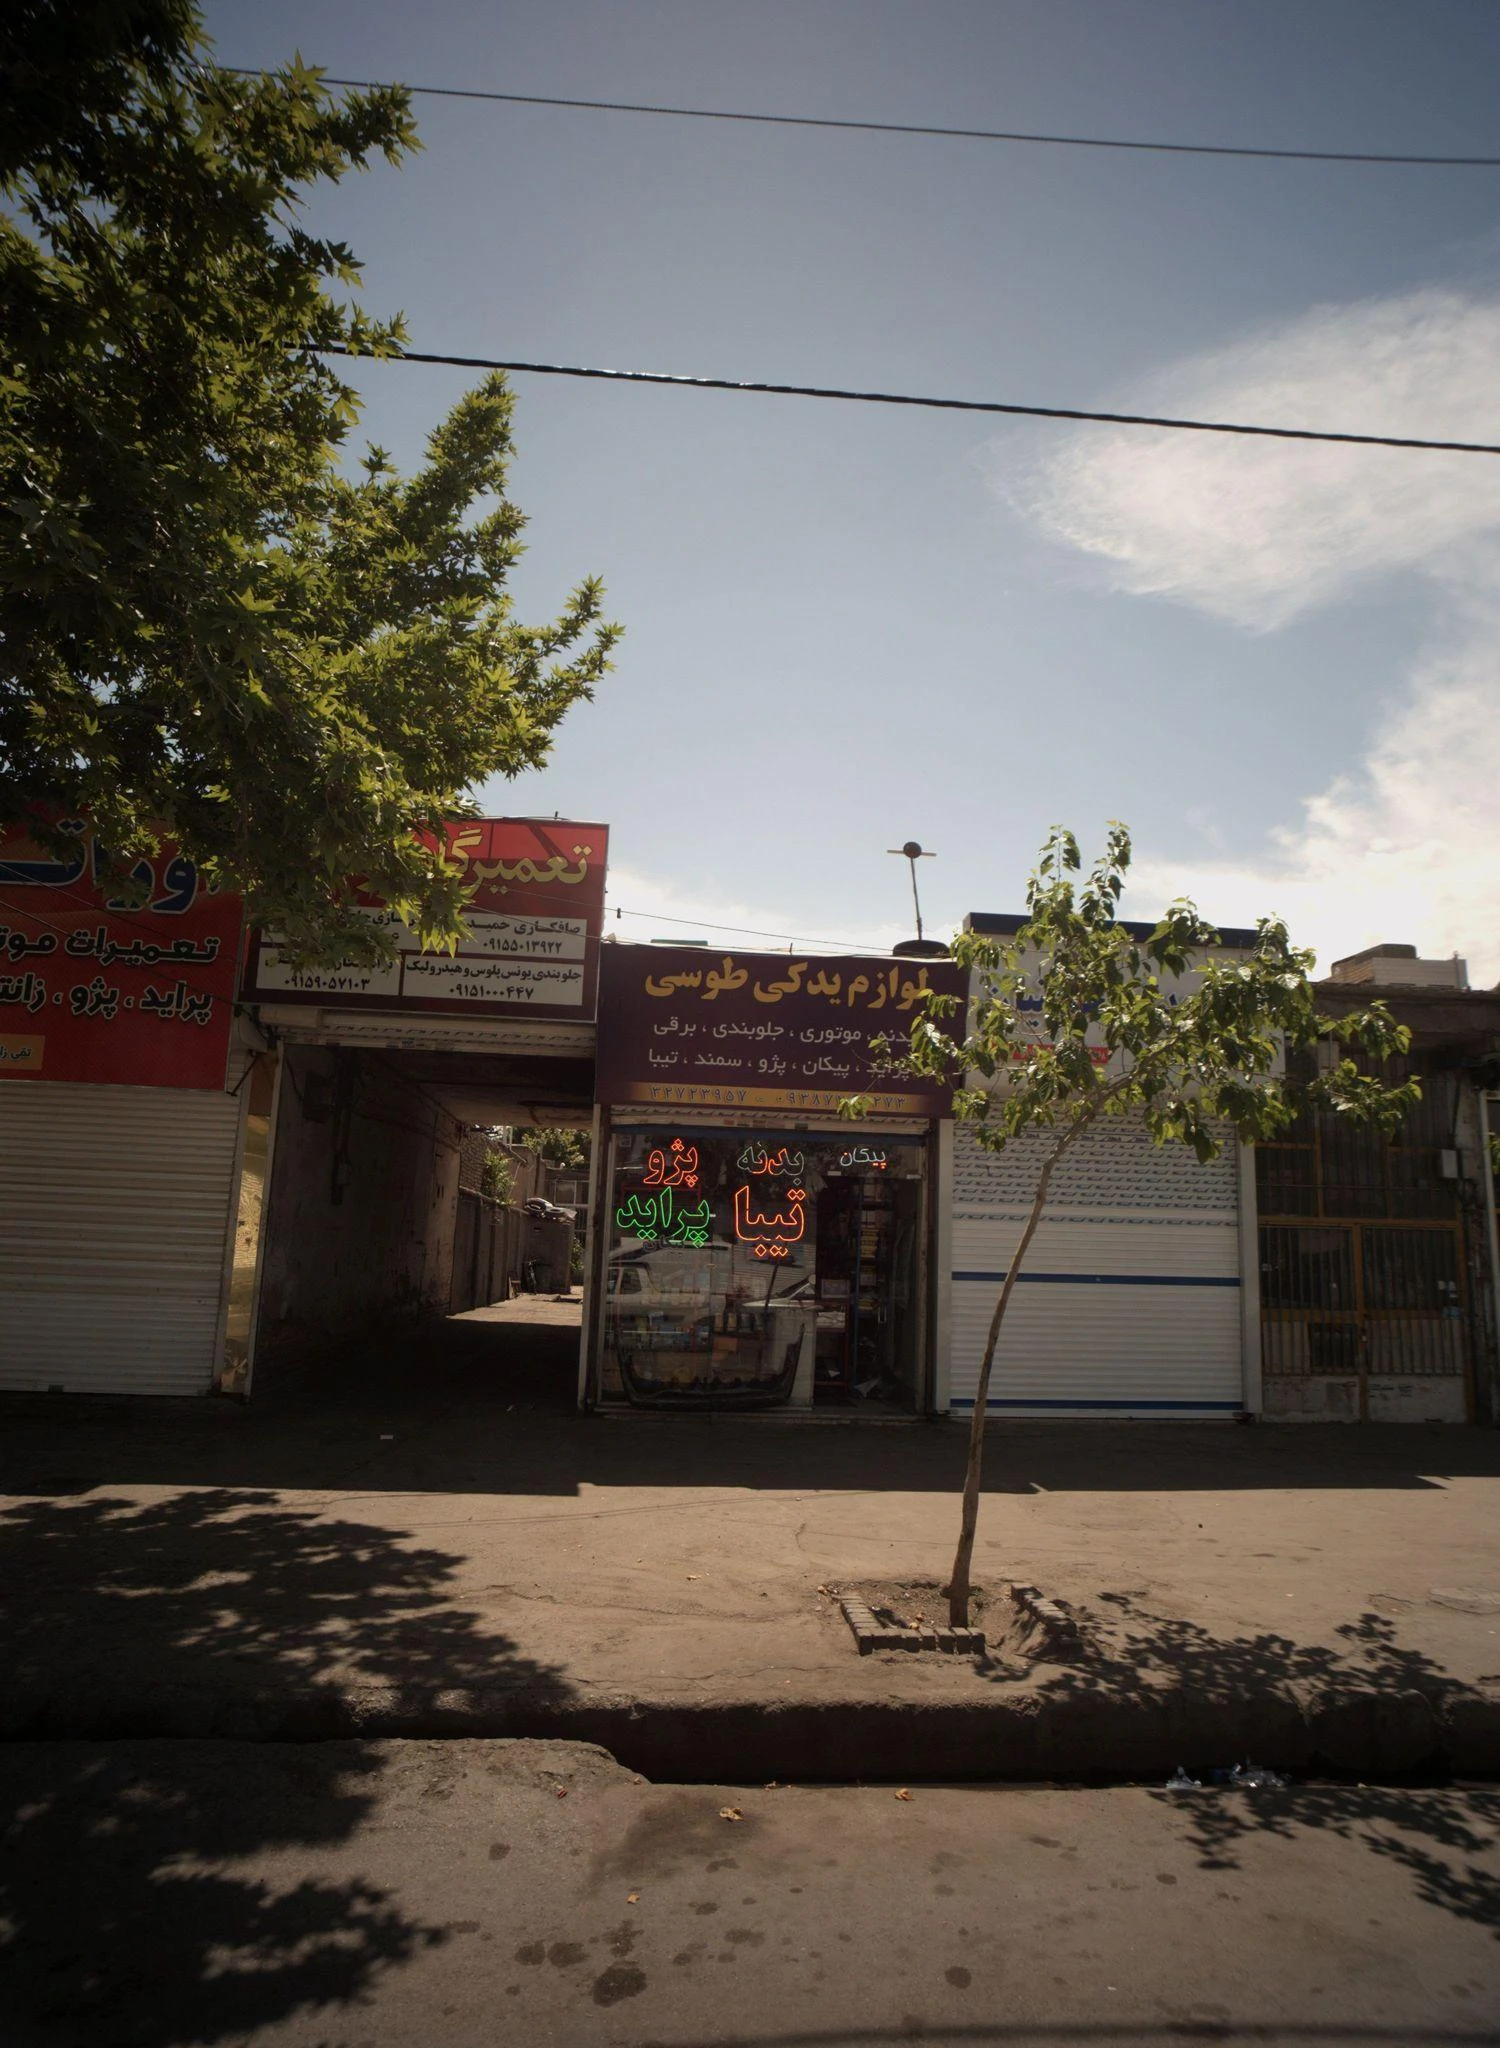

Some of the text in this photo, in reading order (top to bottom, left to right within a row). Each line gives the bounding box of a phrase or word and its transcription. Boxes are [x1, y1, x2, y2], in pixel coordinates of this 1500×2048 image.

[418, 828, 592, 898] تعمیرگا
[514, 919, 581, 936] صافکاری
[65, 926, 221, 966] تعمیرات
[483, 937, 563, 955] ۰۹۱۵۵۰۱۳۹۲۲
[284, 975, 371, 991] ۰۹۱۵۹۰۵۷۱۰۳
[501, 965, 532, 981] یونس
[532, 969, 582, 984] جلوبندی
[644, 955, 929, 1011] لوازم یدکی طوسی
[69, 976, 120, 1020] پژو
[139, 979, 213, 1025] پراید
[449, 983, 535, 1000] ۰۹۱۵۱۰۰۰۴۴۷
[653, 1016, 698, 1037] برقی
[712, 1021, 785, 1041] جلوبندی
[799, 1026, 862, 1045] موتوری
[648, 1047, 679, 1069] تیبا
[694, 1052, 743, 1068] سمند
[757, 1053, 787, 1077] پژو
[802, 1056, 850, 1079] پیکان
[643, 1138, 699, 1188] پژو
[736, 1140, 806, 1187] بدنه
[840, 1146, 887, 1171] پیکان
[616, 1186, 712, 1250] پراید
[734, 1185, 807, 1258] تیبا
